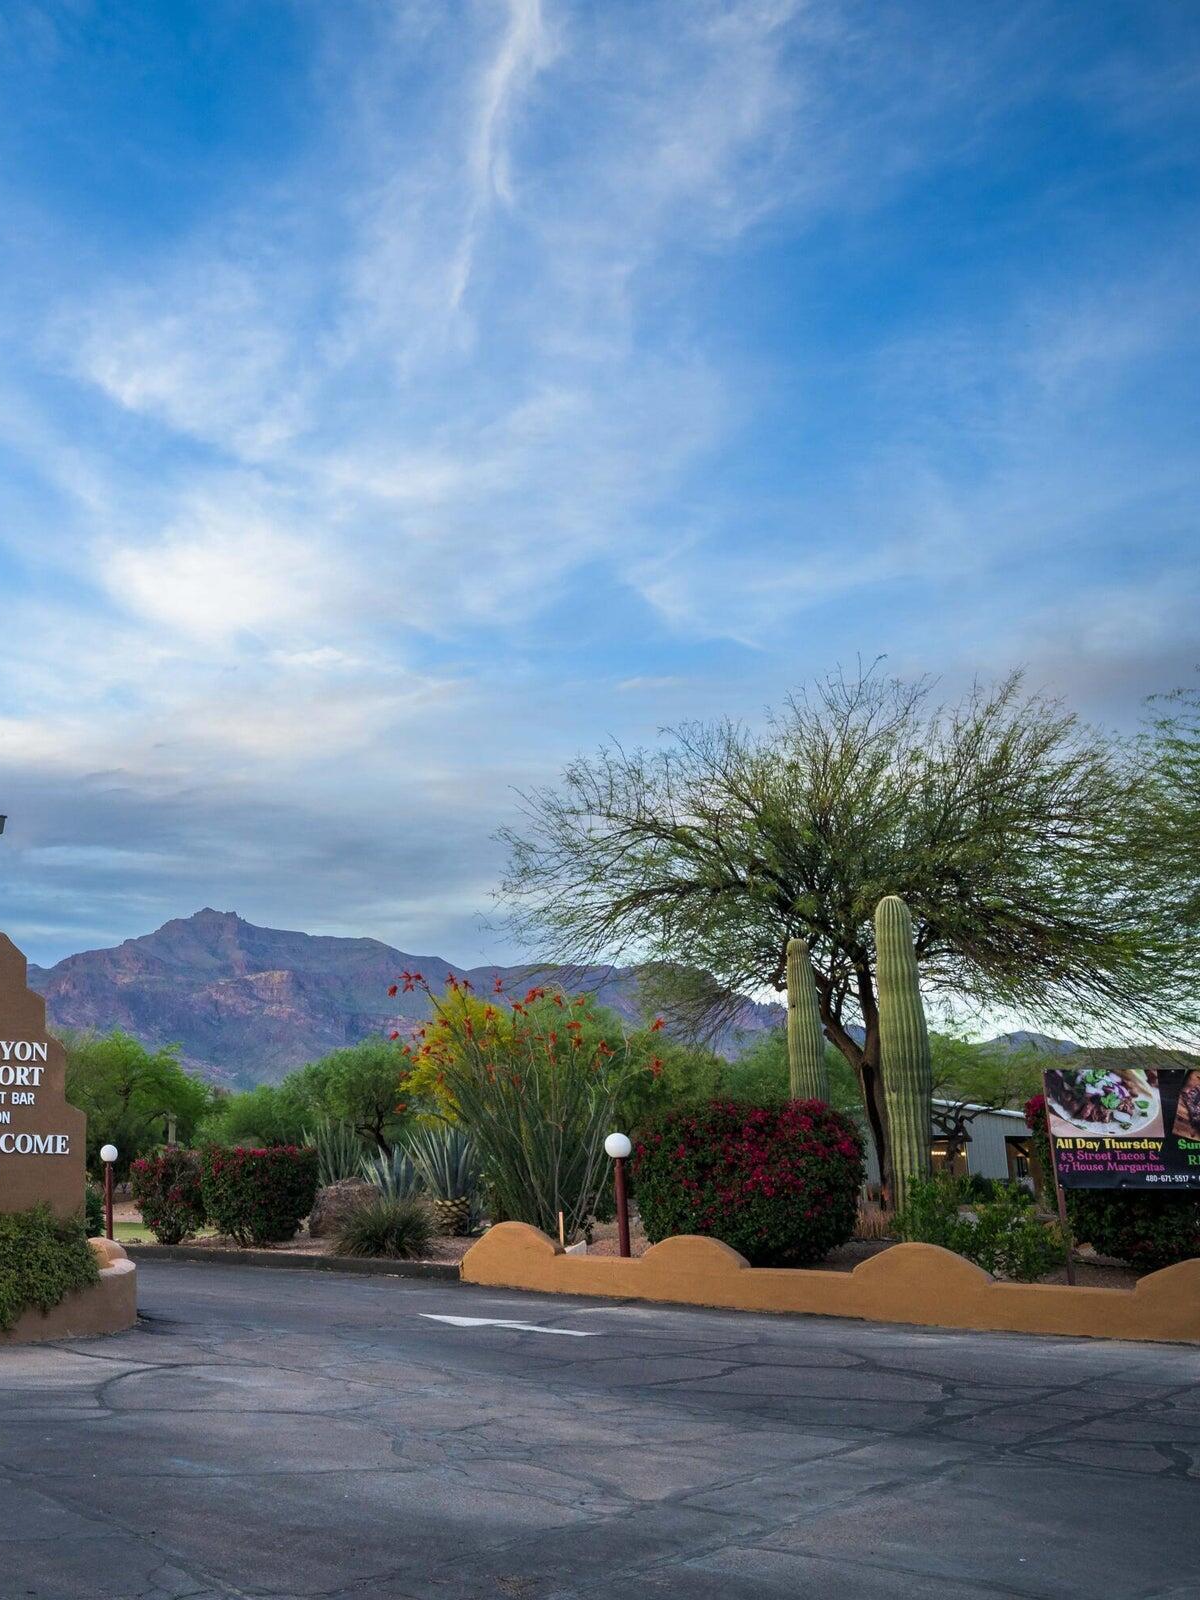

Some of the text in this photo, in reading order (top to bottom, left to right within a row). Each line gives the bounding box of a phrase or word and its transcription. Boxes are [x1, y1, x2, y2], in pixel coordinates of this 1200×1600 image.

[11, 1092, 35, 1105] BAR
[1056, 1138, 1163, 1152] All Day Thursday
[1076, 1150, 1111, 1160] Street
[1114, 1150, 1146, 1160] Tacos
[1149, 1150, 1159, 1160] &
[1072, 1161, 1104, 1171] House
[1107, 1162, 1166, 1173] Margaritas
[1145, 1174, 1189, 1183] 480-671-5517
